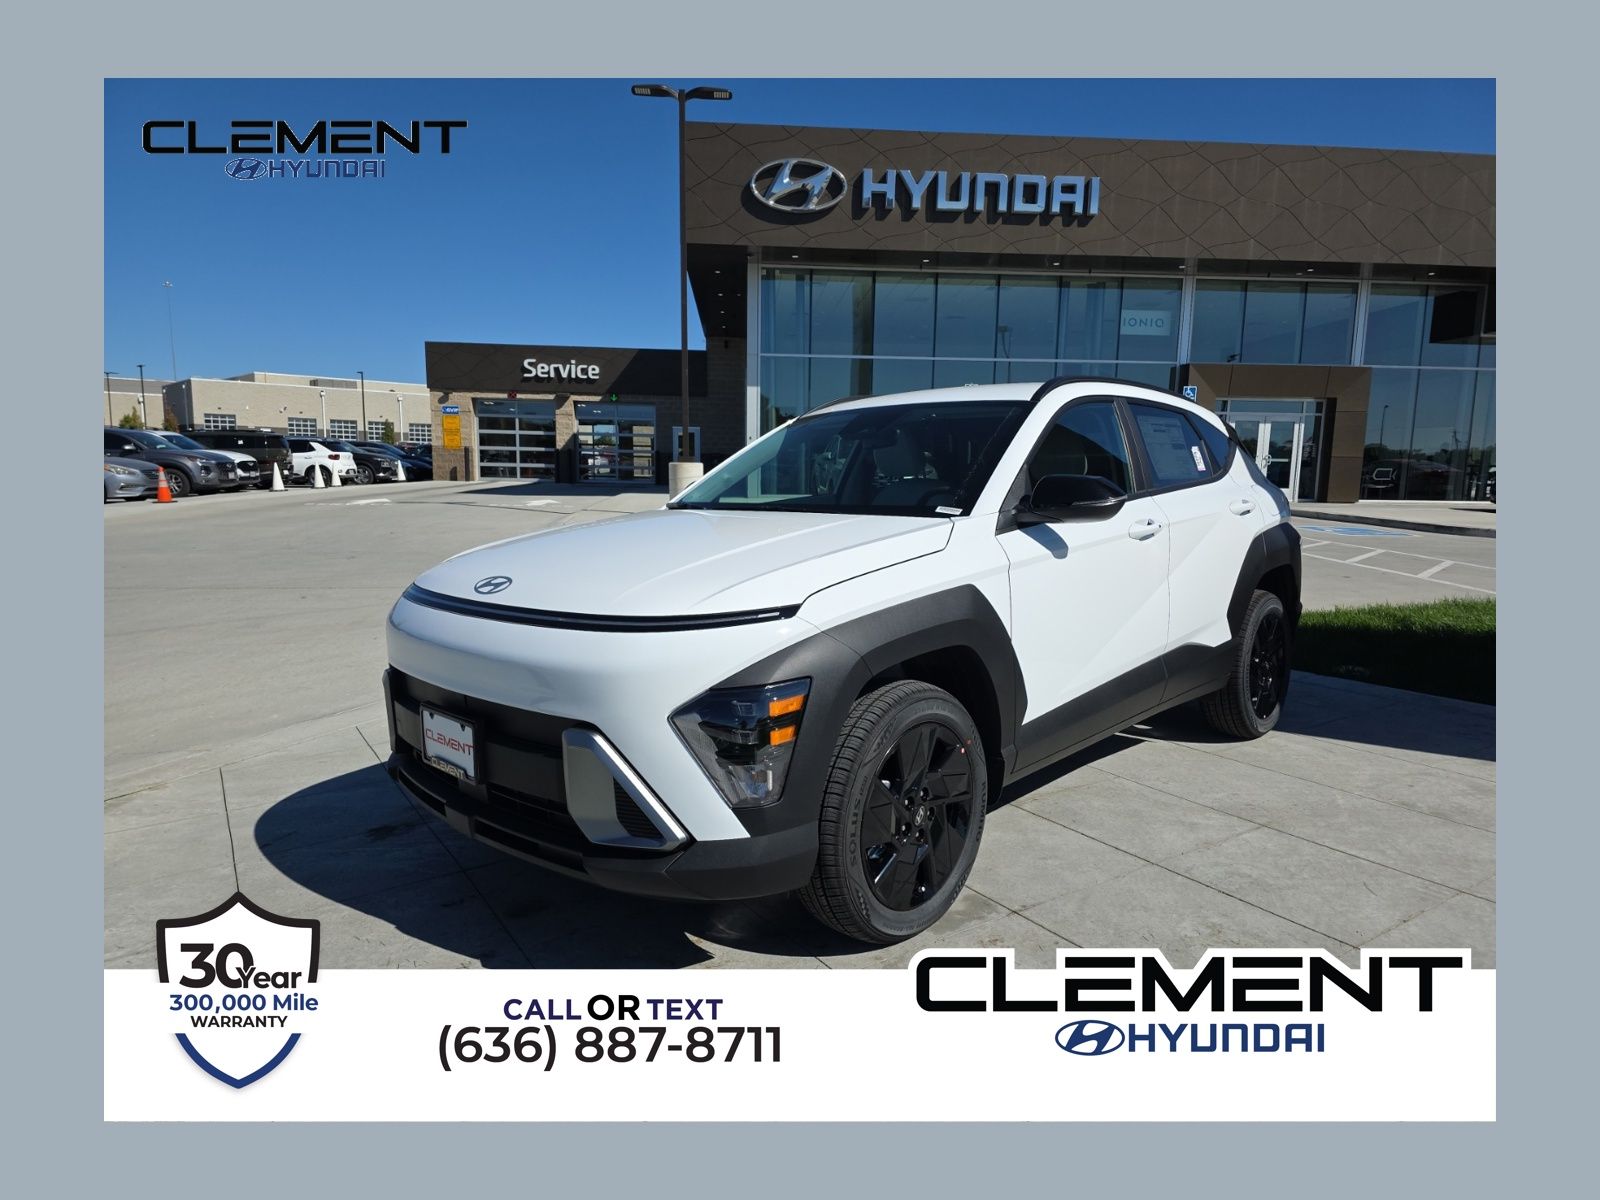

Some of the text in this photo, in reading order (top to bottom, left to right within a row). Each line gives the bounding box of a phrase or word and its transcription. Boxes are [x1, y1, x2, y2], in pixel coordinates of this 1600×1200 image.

[861, 168, 1101, 216] HYUNDAI
[1123, 317, 1164, 328] IONIQ
[522, 358, 600, 379] Service
[426, 728, 474, 755] CLEMENT
